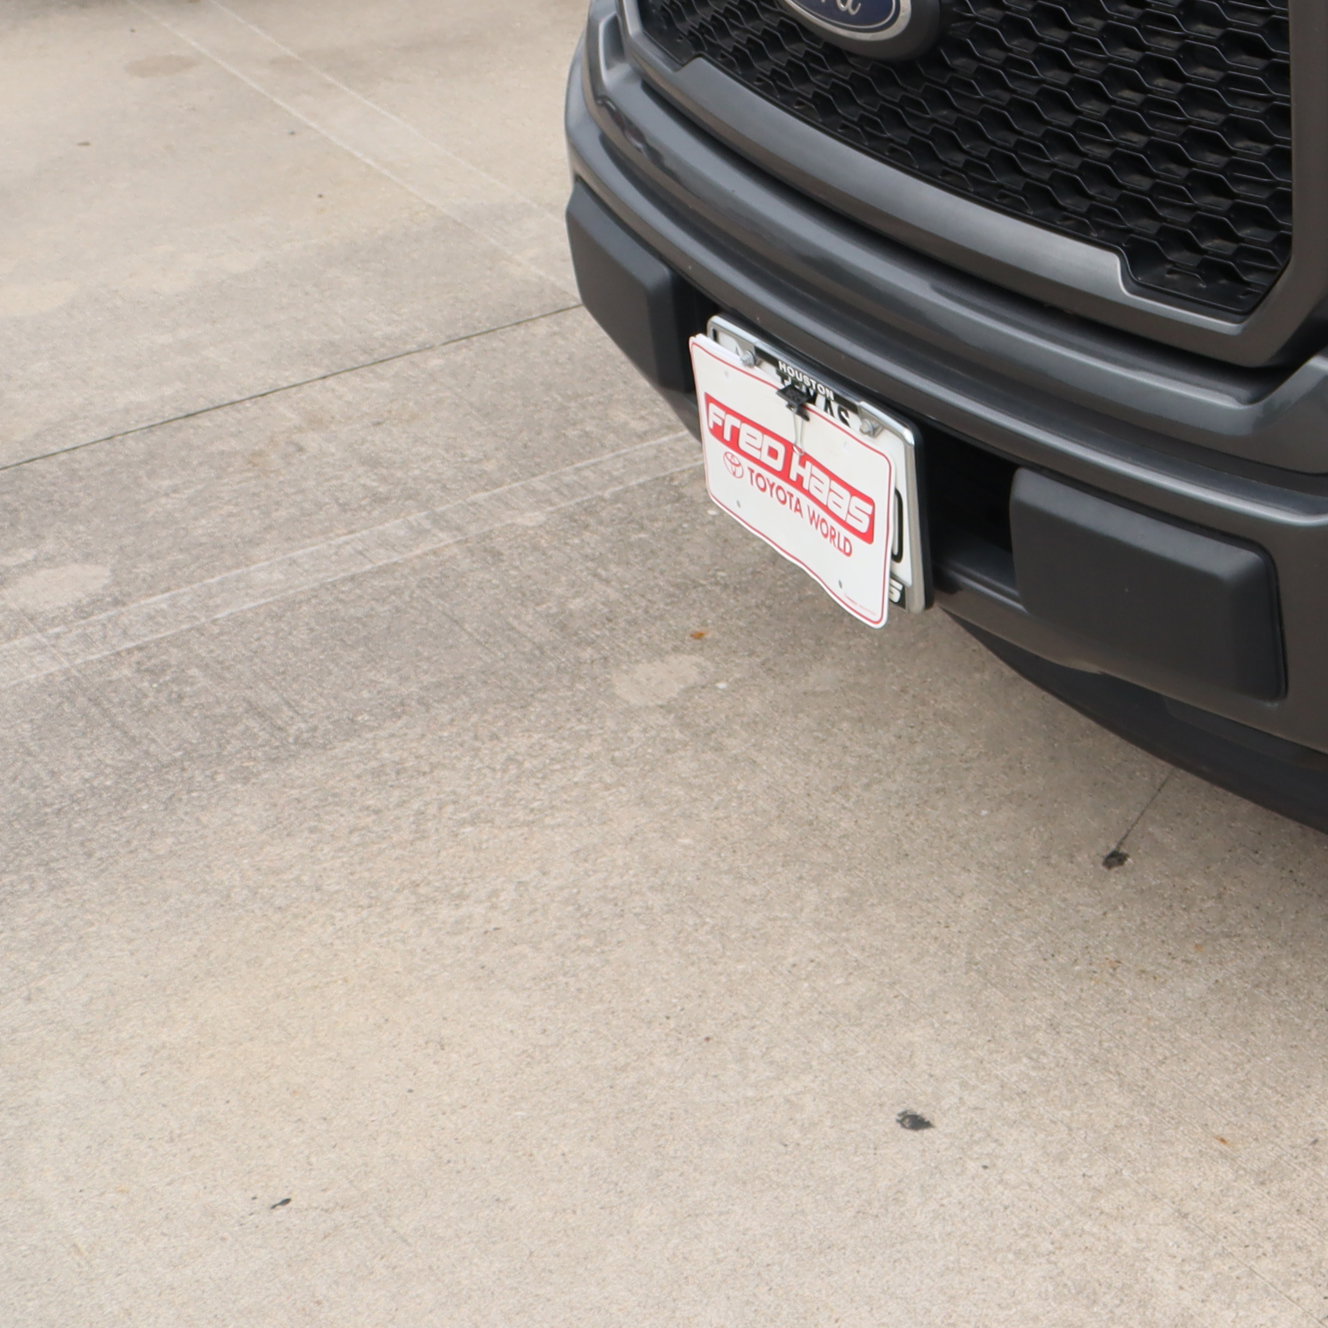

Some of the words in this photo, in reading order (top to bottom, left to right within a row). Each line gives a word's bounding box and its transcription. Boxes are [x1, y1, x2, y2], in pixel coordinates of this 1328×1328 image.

[777, 359, 835, 401] HOUSTON
[747, 467, 803, 520] TOYOTA
[807, 504, 853, 558] WORLD
